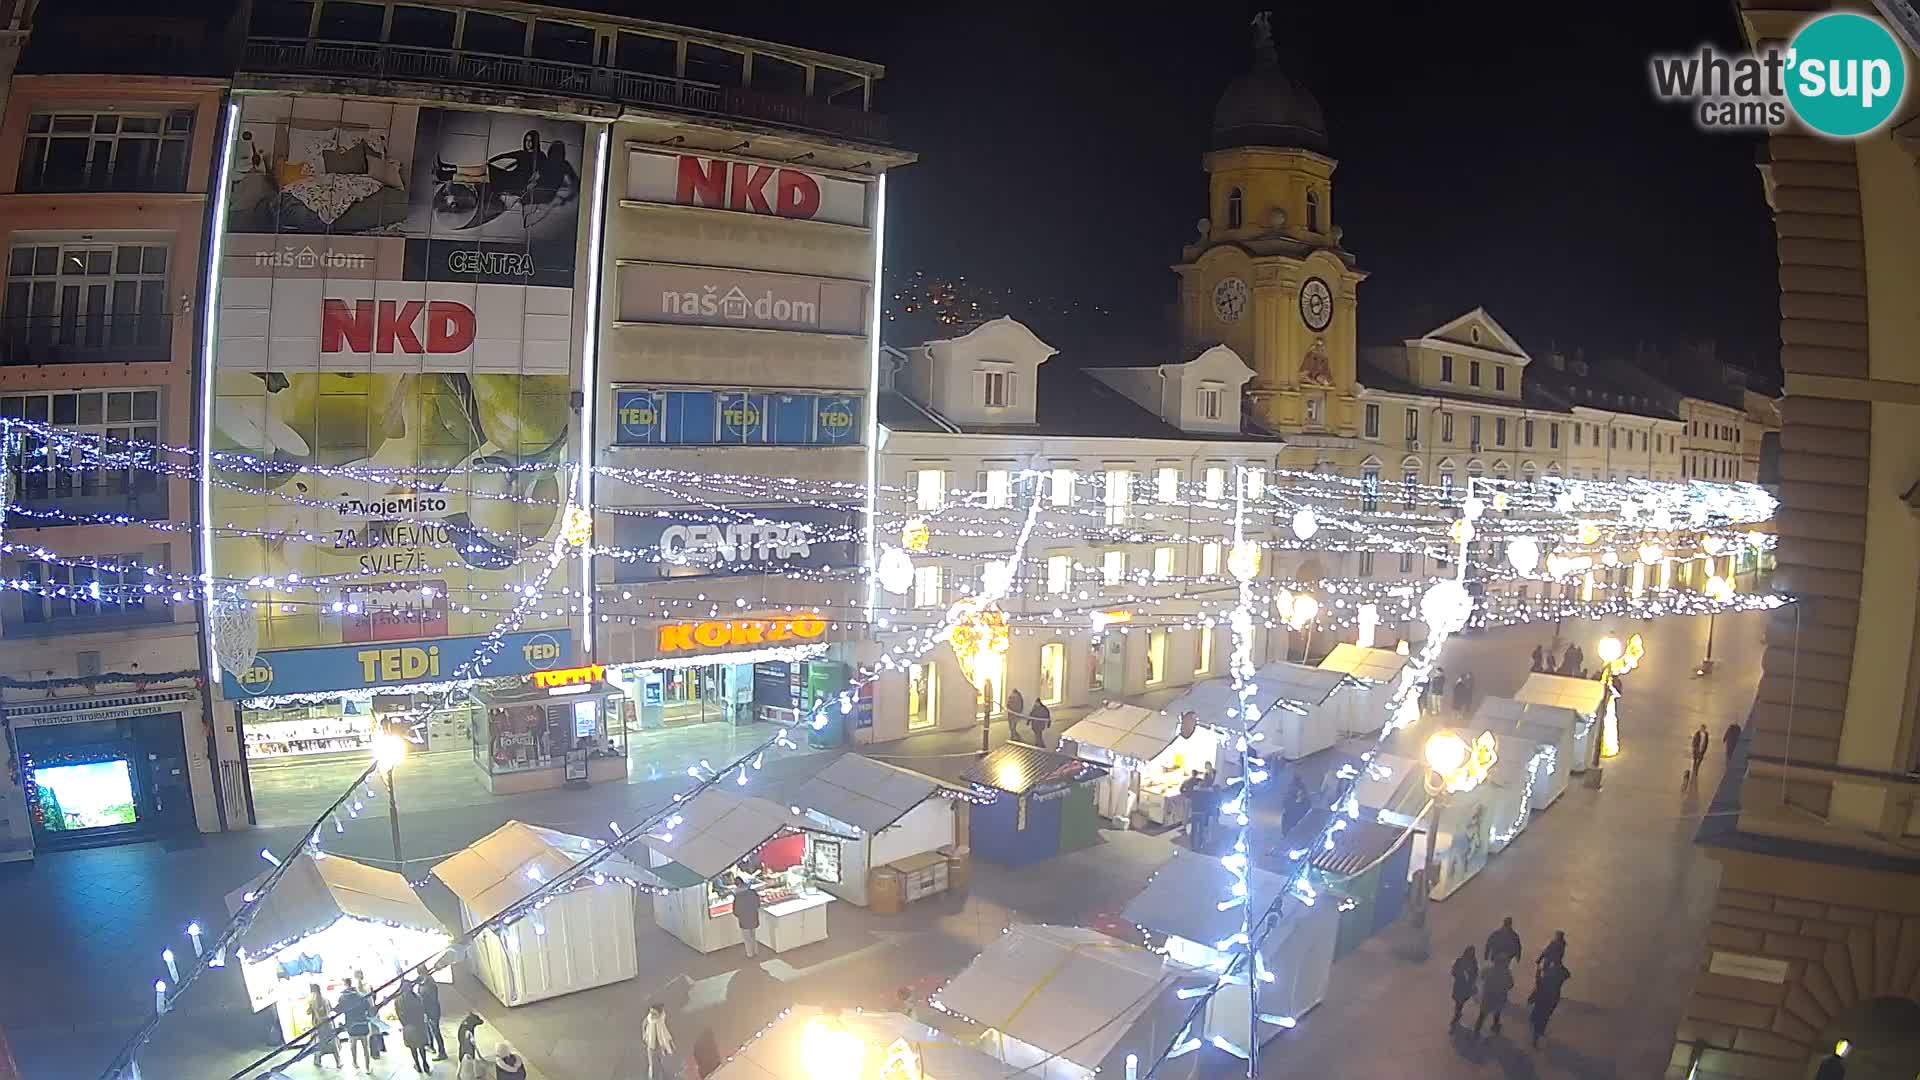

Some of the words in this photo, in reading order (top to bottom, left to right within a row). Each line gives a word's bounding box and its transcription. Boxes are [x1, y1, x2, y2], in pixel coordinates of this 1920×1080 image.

[676, 155, 821, 219] NKD
[255, 244, 296, 269] naš
[319, 247, 366, 270] dom
[448, 250, 536, 277] CENTRA
[661, 284, 718, 316] naš
[754, 290, 816, 325] dom
[320, 298, 477, 354] NKD
[619, 408, 658, 426] TEDi
[724, 409, 760, 426] TEDi
[338, 498, 447, 516] #TvojeMisto
[334, 527, 359, 549] ZA
[368, 525, 450, 549] DNEVNO
[659, 522, 811, 563] CENTRA
[657, 612, 828, 652] KORZO
[358, 645, 440, 682] TEDi
[524, 643, 561, 660] TEDi
